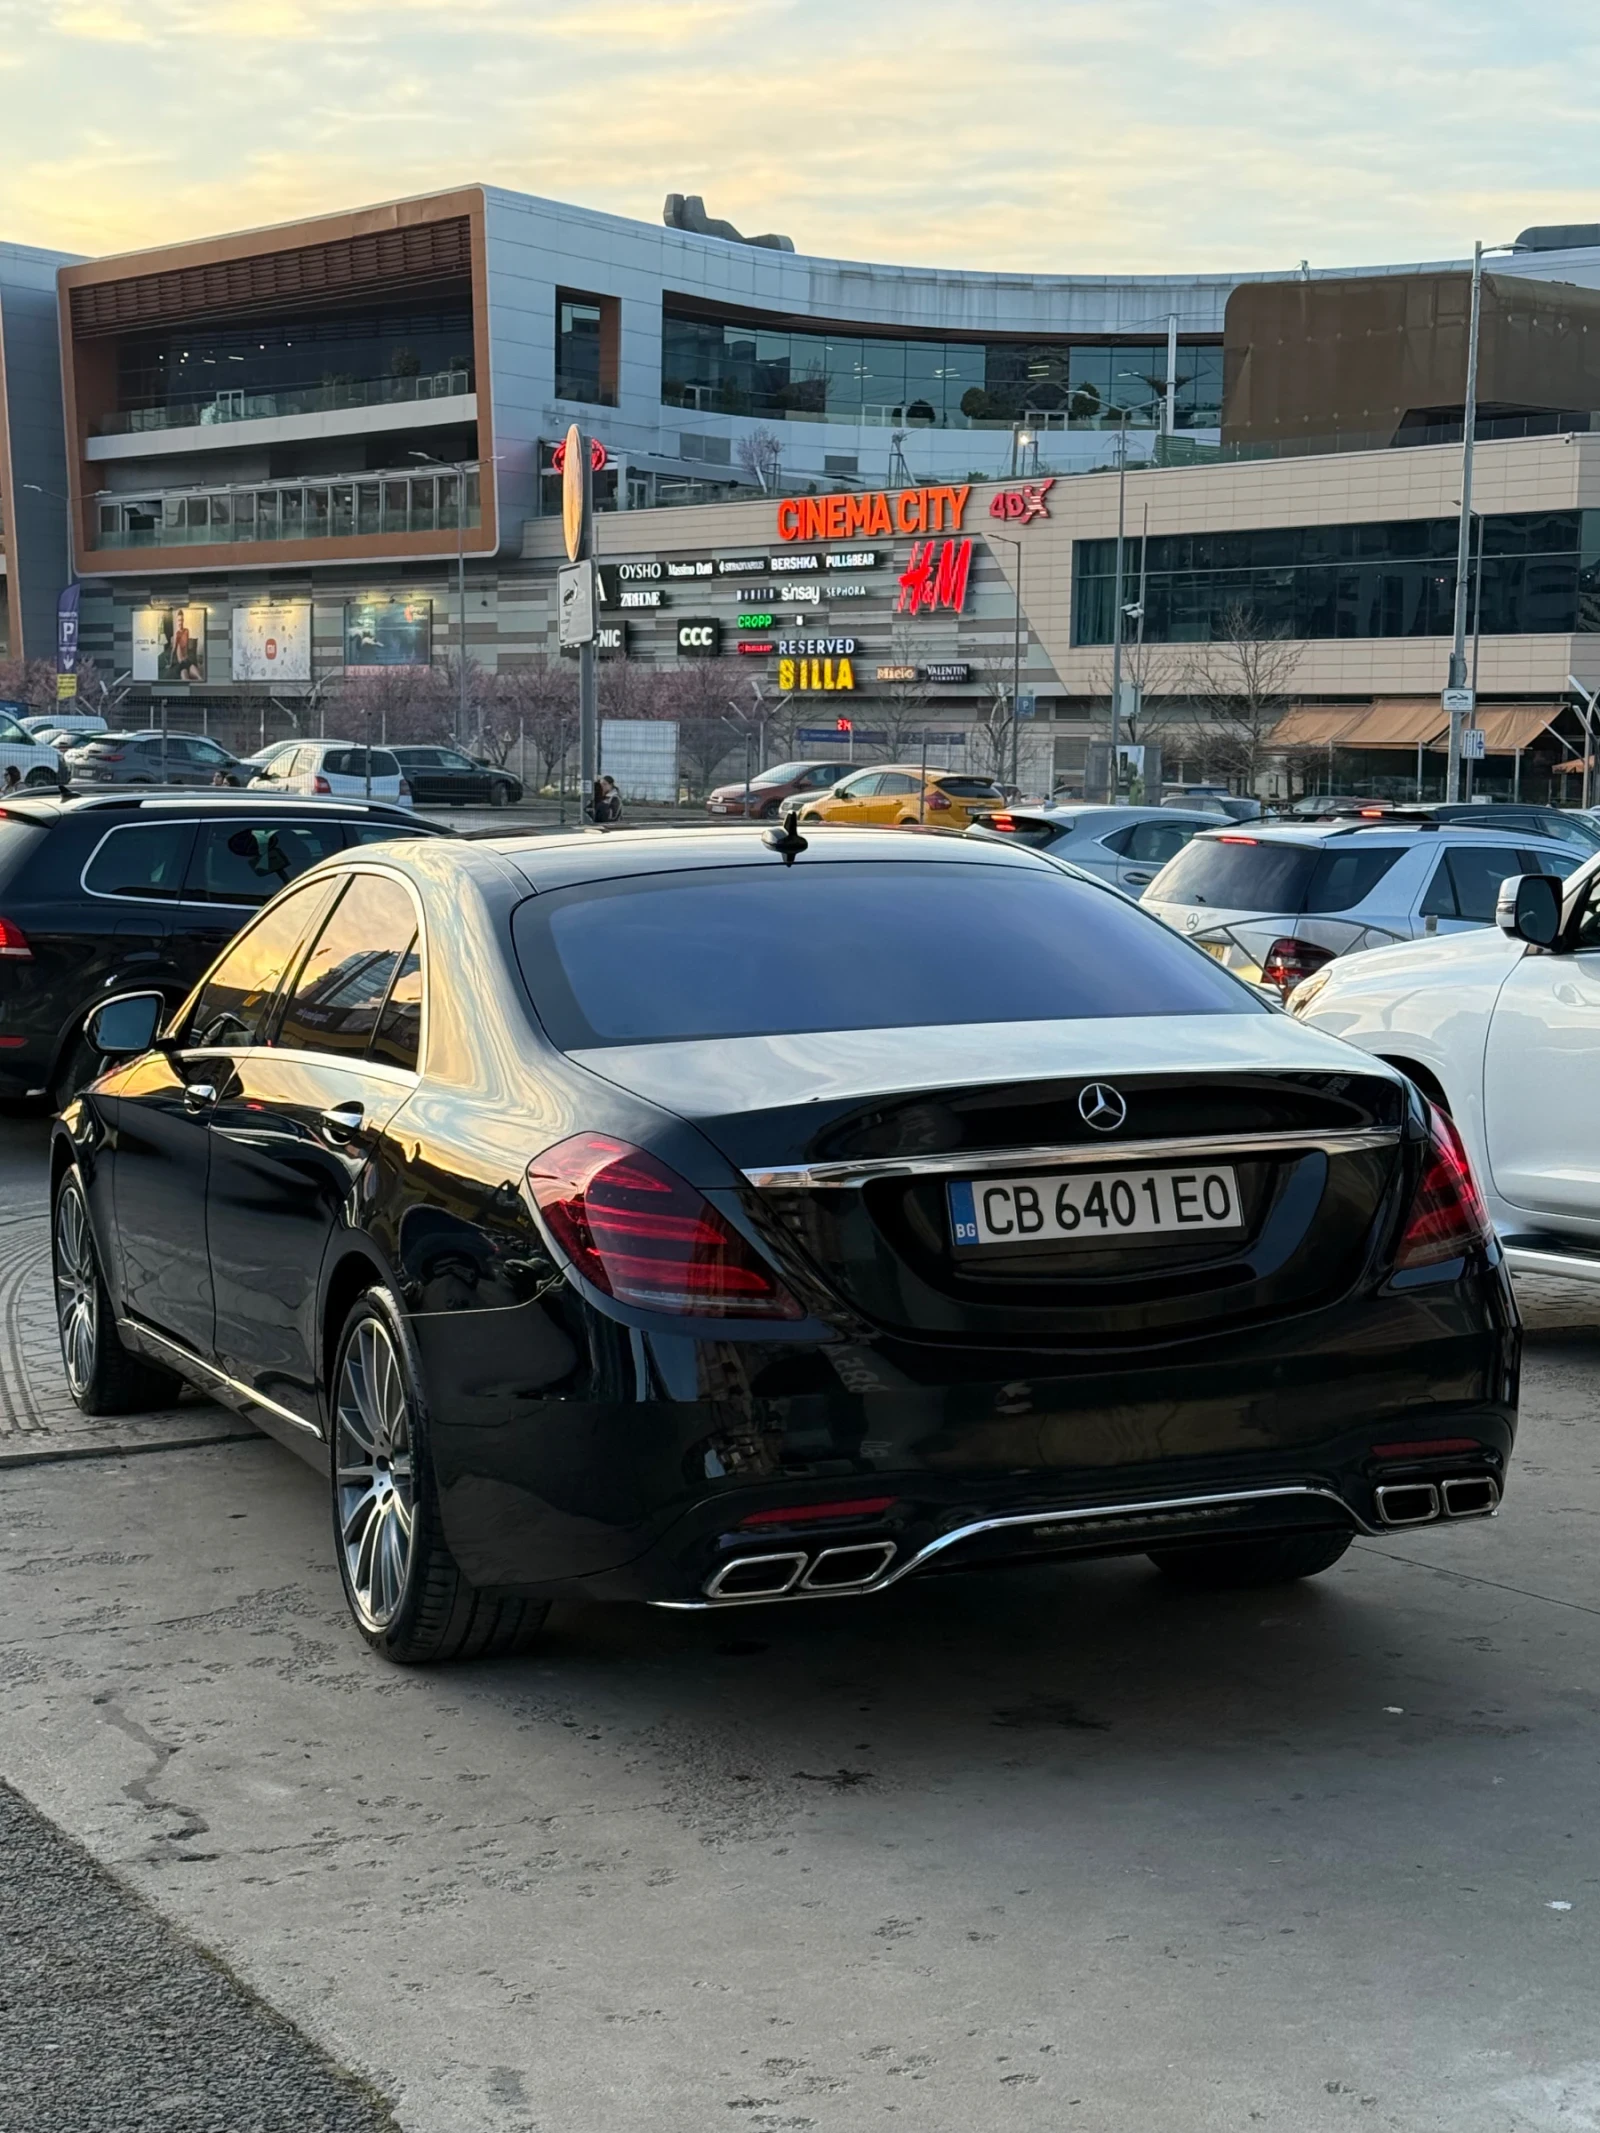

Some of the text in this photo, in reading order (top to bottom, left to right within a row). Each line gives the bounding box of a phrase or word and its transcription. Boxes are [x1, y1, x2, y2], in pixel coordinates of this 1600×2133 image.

[989, 478, 1054, 525] 4DX
[777, 485, 970, 541] CINEMA CITY
[771, 555, 818, 571] BERSHKA
[825, 553, 875, 568] PULL&BEAR
[619, 562, 662, 580] OYSHO
[897, 537, 972, 616] H&M
[781, 583, 820, 605] sinsay
[826, 586, 866, 598] SEPHORA
[738, 614, 773, 629] CROPP
[63, 622, 75, 642] P
[679, 626, 713, 647] CCC
[778, 639, 855, 655] RESERVED
[779, 658, 854, 690] BILLA
[926, 665, 967, 676] VALENTIN
[982, 1184, 1045, 1236] CB
[1055, 1177, 1161, 1231] 6401
[956, 1222, 976, 1239] BG
